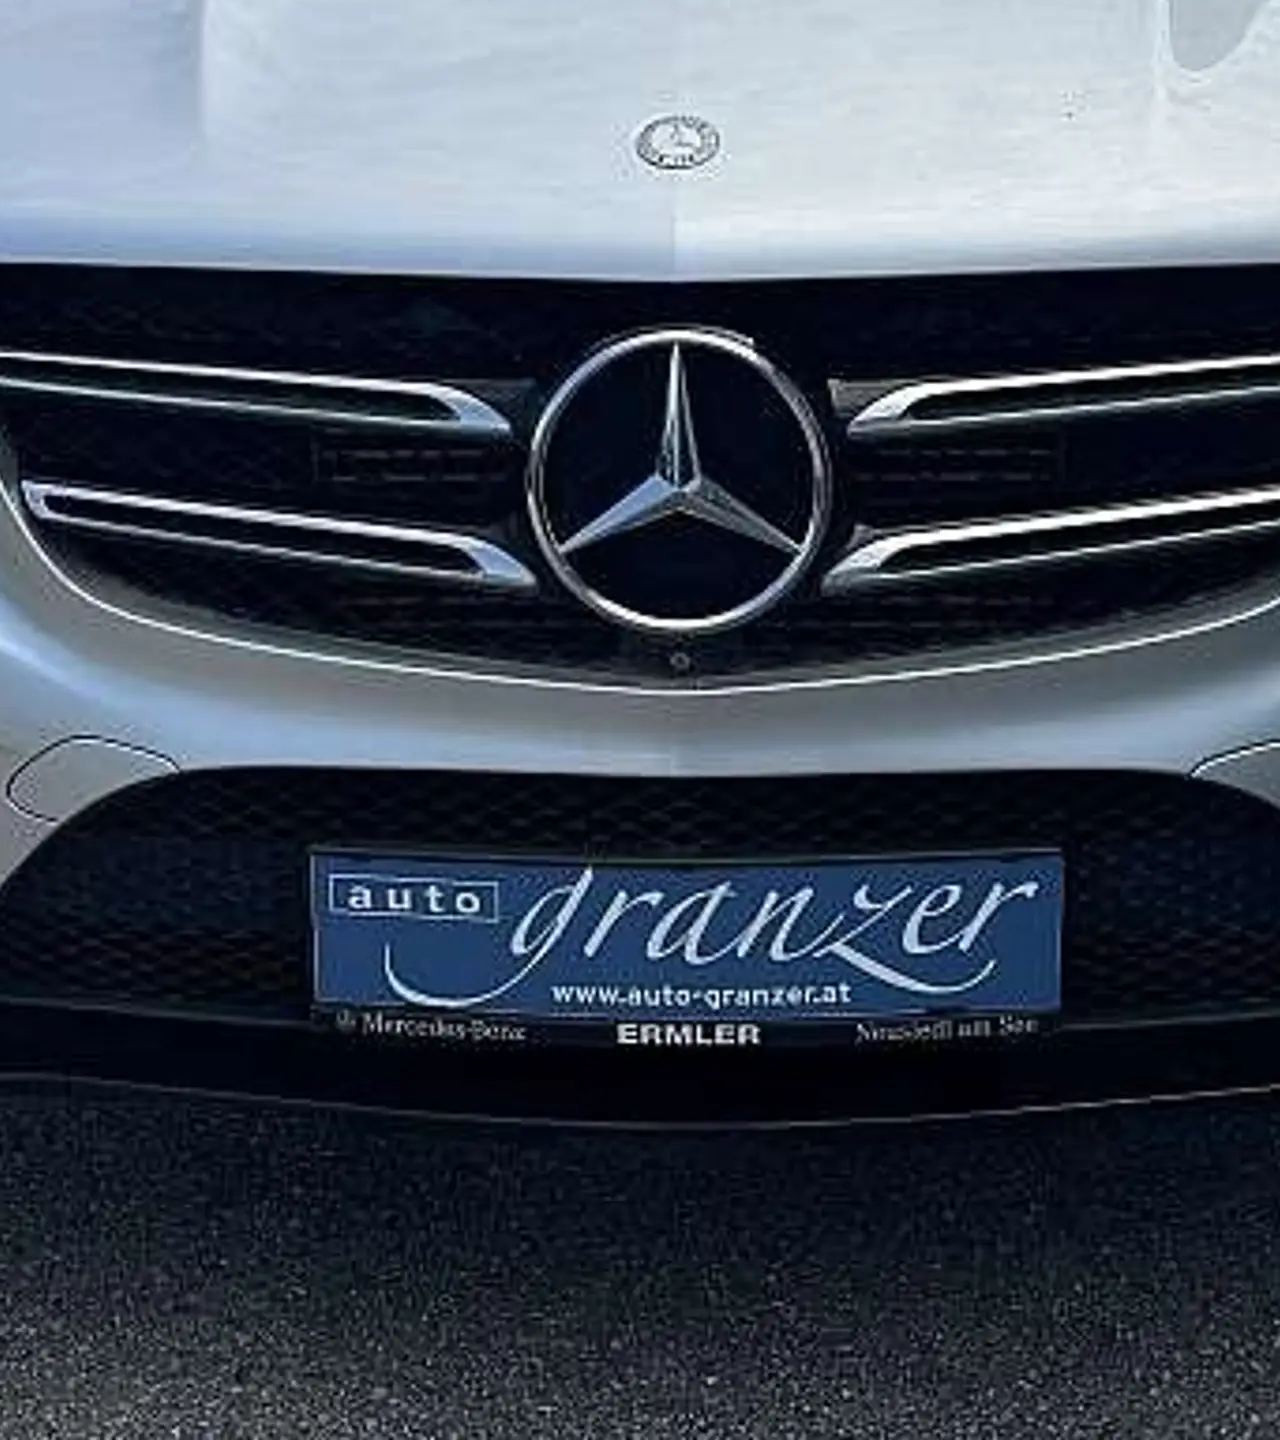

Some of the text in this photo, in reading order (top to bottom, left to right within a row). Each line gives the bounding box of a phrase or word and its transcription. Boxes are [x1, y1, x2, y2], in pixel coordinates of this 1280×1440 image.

[347, 884, 482, 914] auto
[384, 864, 1040, 1008] granzer
[549, 982, 853, 1011] www.auto-granzer.at
[617, 1023, 761, 1046] ERMLER
